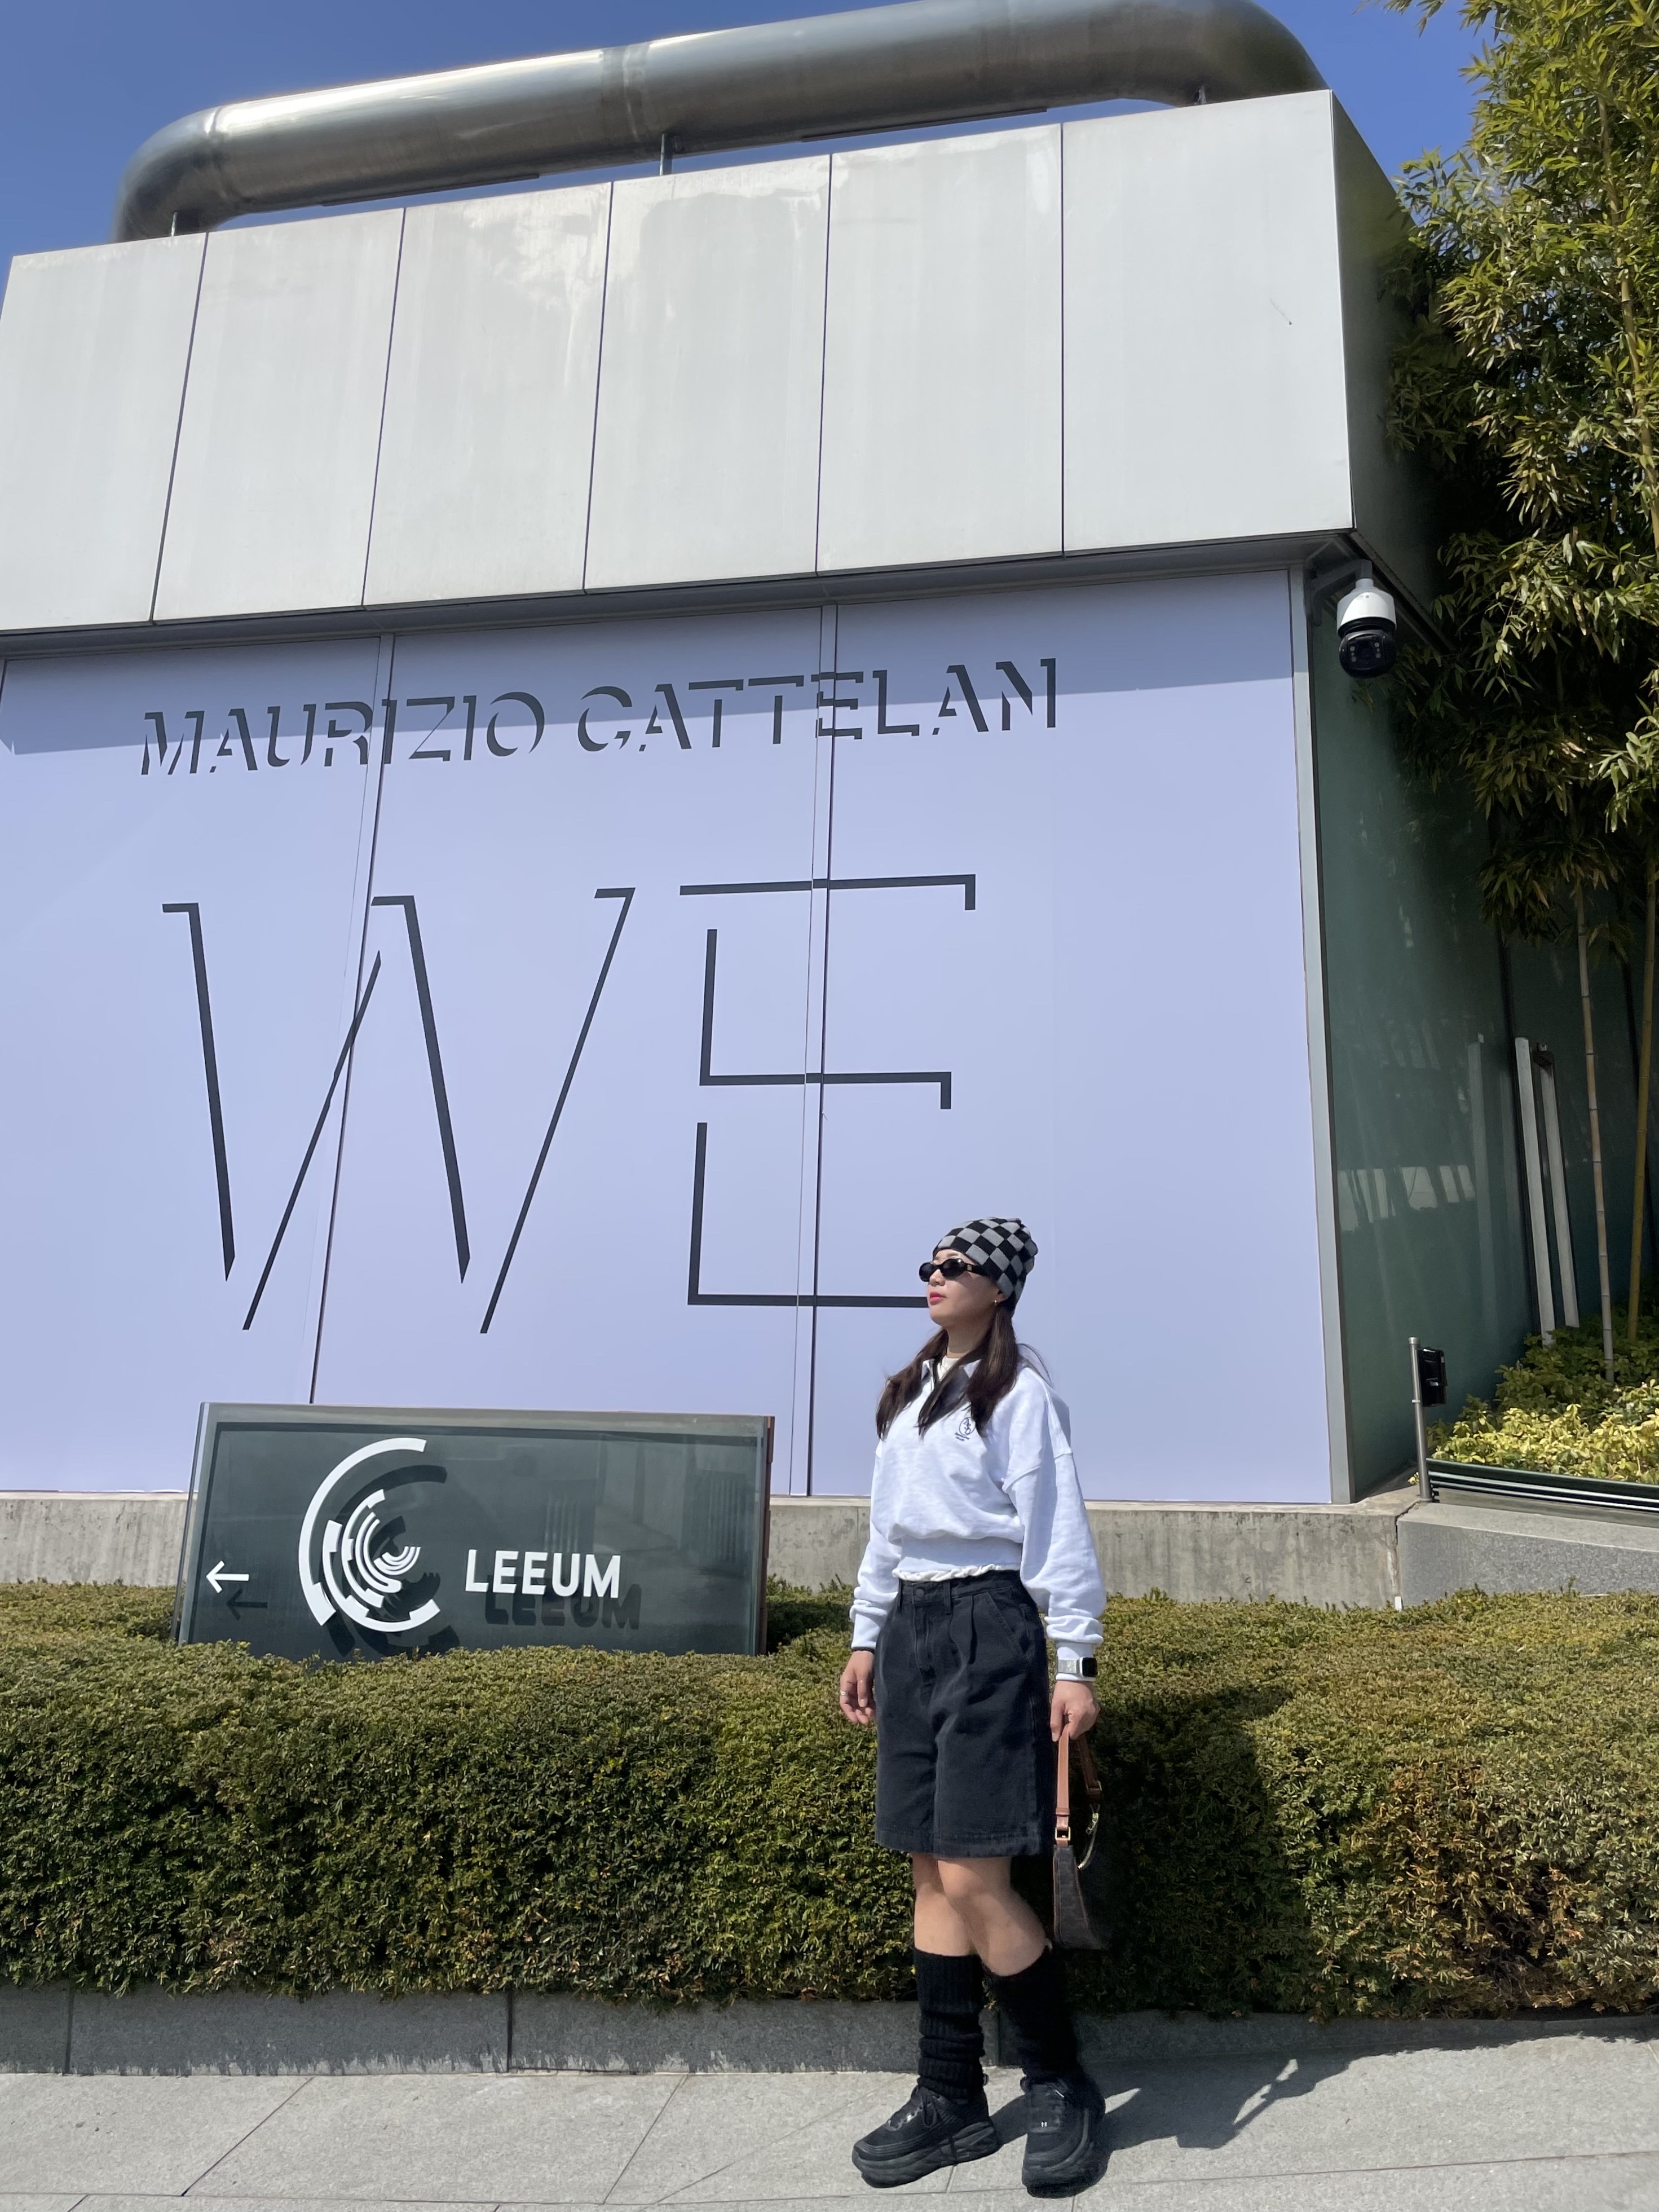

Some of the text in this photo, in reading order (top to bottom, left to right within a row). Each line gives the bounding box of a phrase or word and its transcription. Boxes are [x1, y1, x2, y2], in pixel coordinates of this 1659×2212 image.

[141, 658, 1056, 775] MAURIZIO CATTELAN
[162, 874, 975, 1333] WE
[465, 1549, 620, 1598] LEEUM
